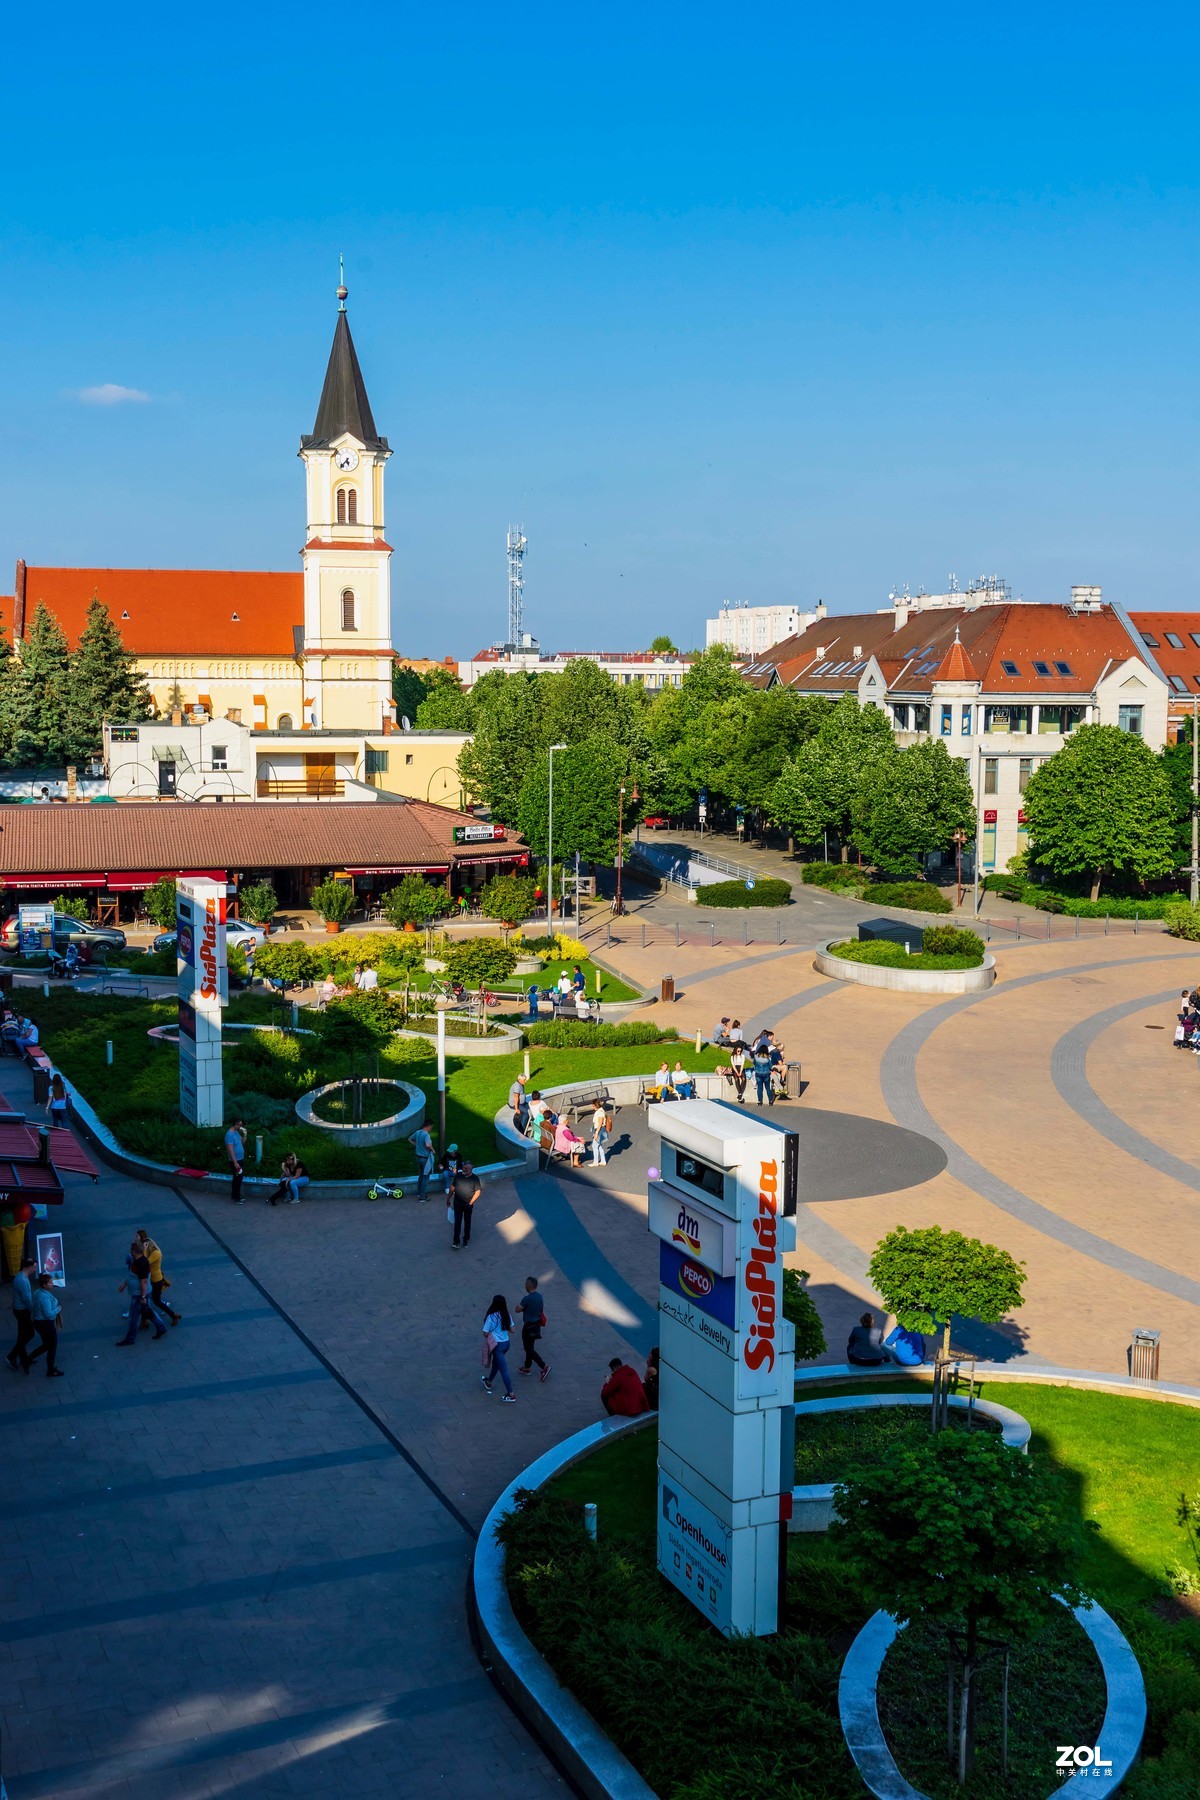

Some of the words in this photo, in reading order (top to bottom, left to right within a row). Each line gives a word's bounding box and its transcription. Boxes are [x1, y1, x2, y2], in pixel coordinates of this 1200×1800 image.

[678, 1205, 699, 1239] dm
[683, 1265, 709, 1291] PEPCO
[744, 1158, 778, 1374] SióPláza
[699, 1317, 731, 1353] Jewelry
[675, 1512, 727, 1568] openhouse
